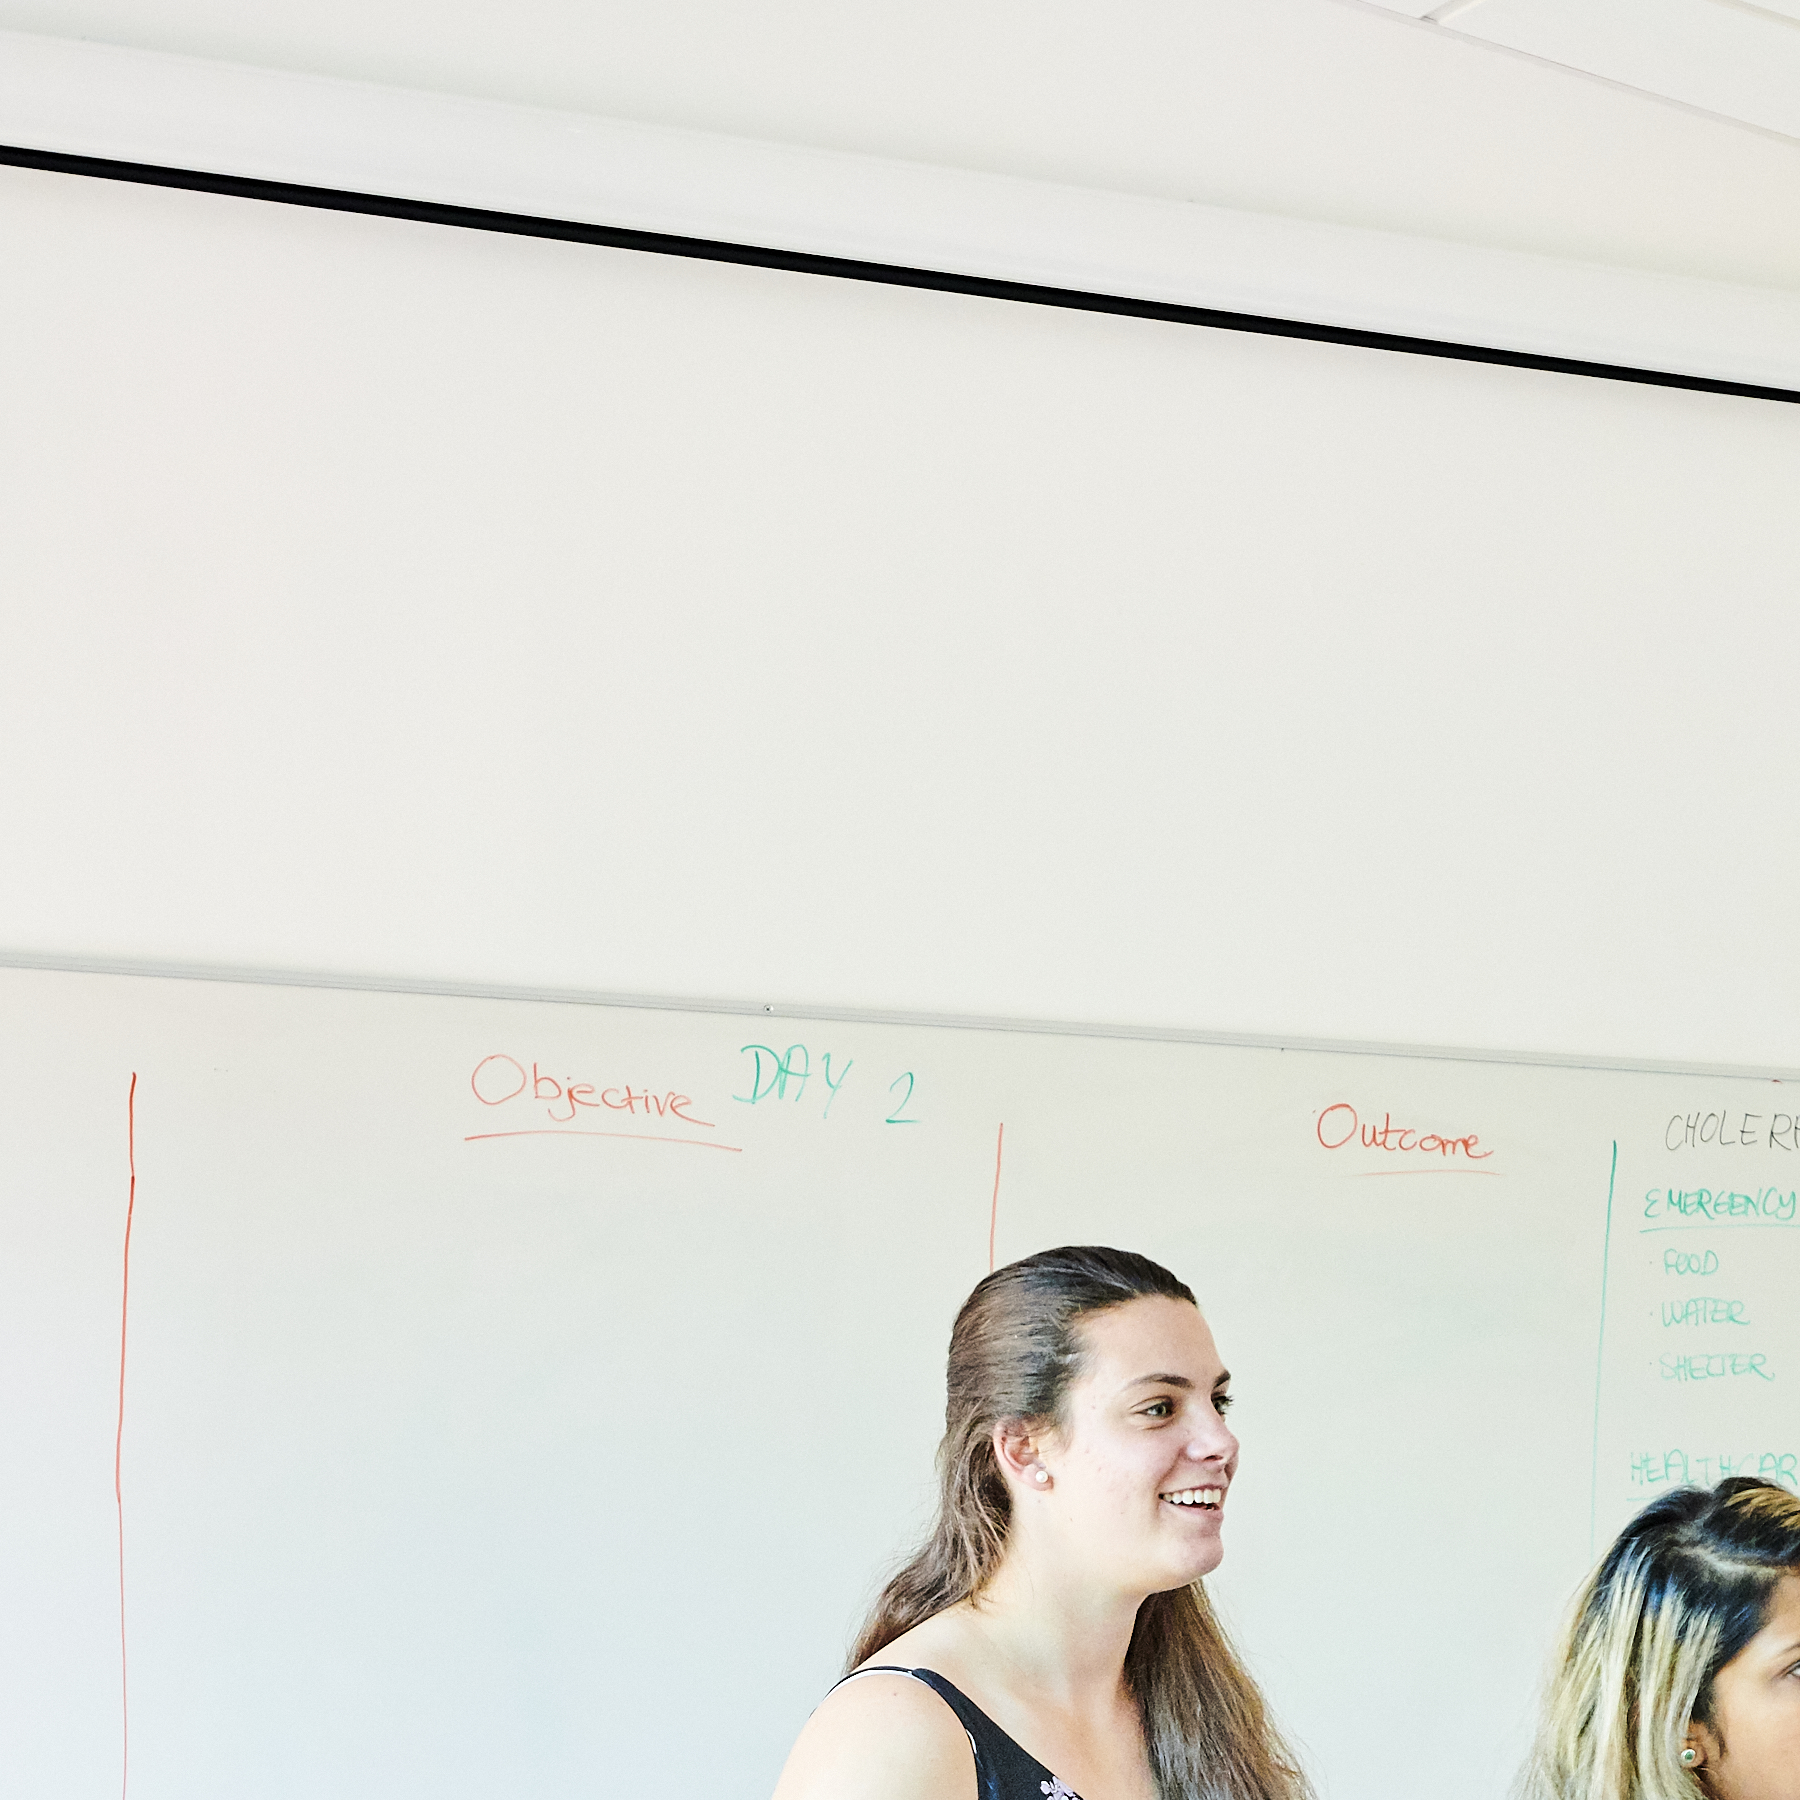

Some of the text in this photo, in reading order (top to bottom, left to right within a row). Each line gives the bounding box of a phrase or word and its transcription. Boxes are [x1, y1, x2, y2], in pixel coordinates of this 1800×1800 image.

[471, 1054, 716, 1127] Objective
[732, 1043, 923, 1123] DAY 2
[1315, 1103, 1494, 1160] Outcome
[1643, 1186, 1797, 1225] EMERGENCY
[1663, 1248, 1720, 1276] FOOD
[1661, 1298, 1750, 1327] WATER
[1658, 1352, 1775, 1383] SHELTER
